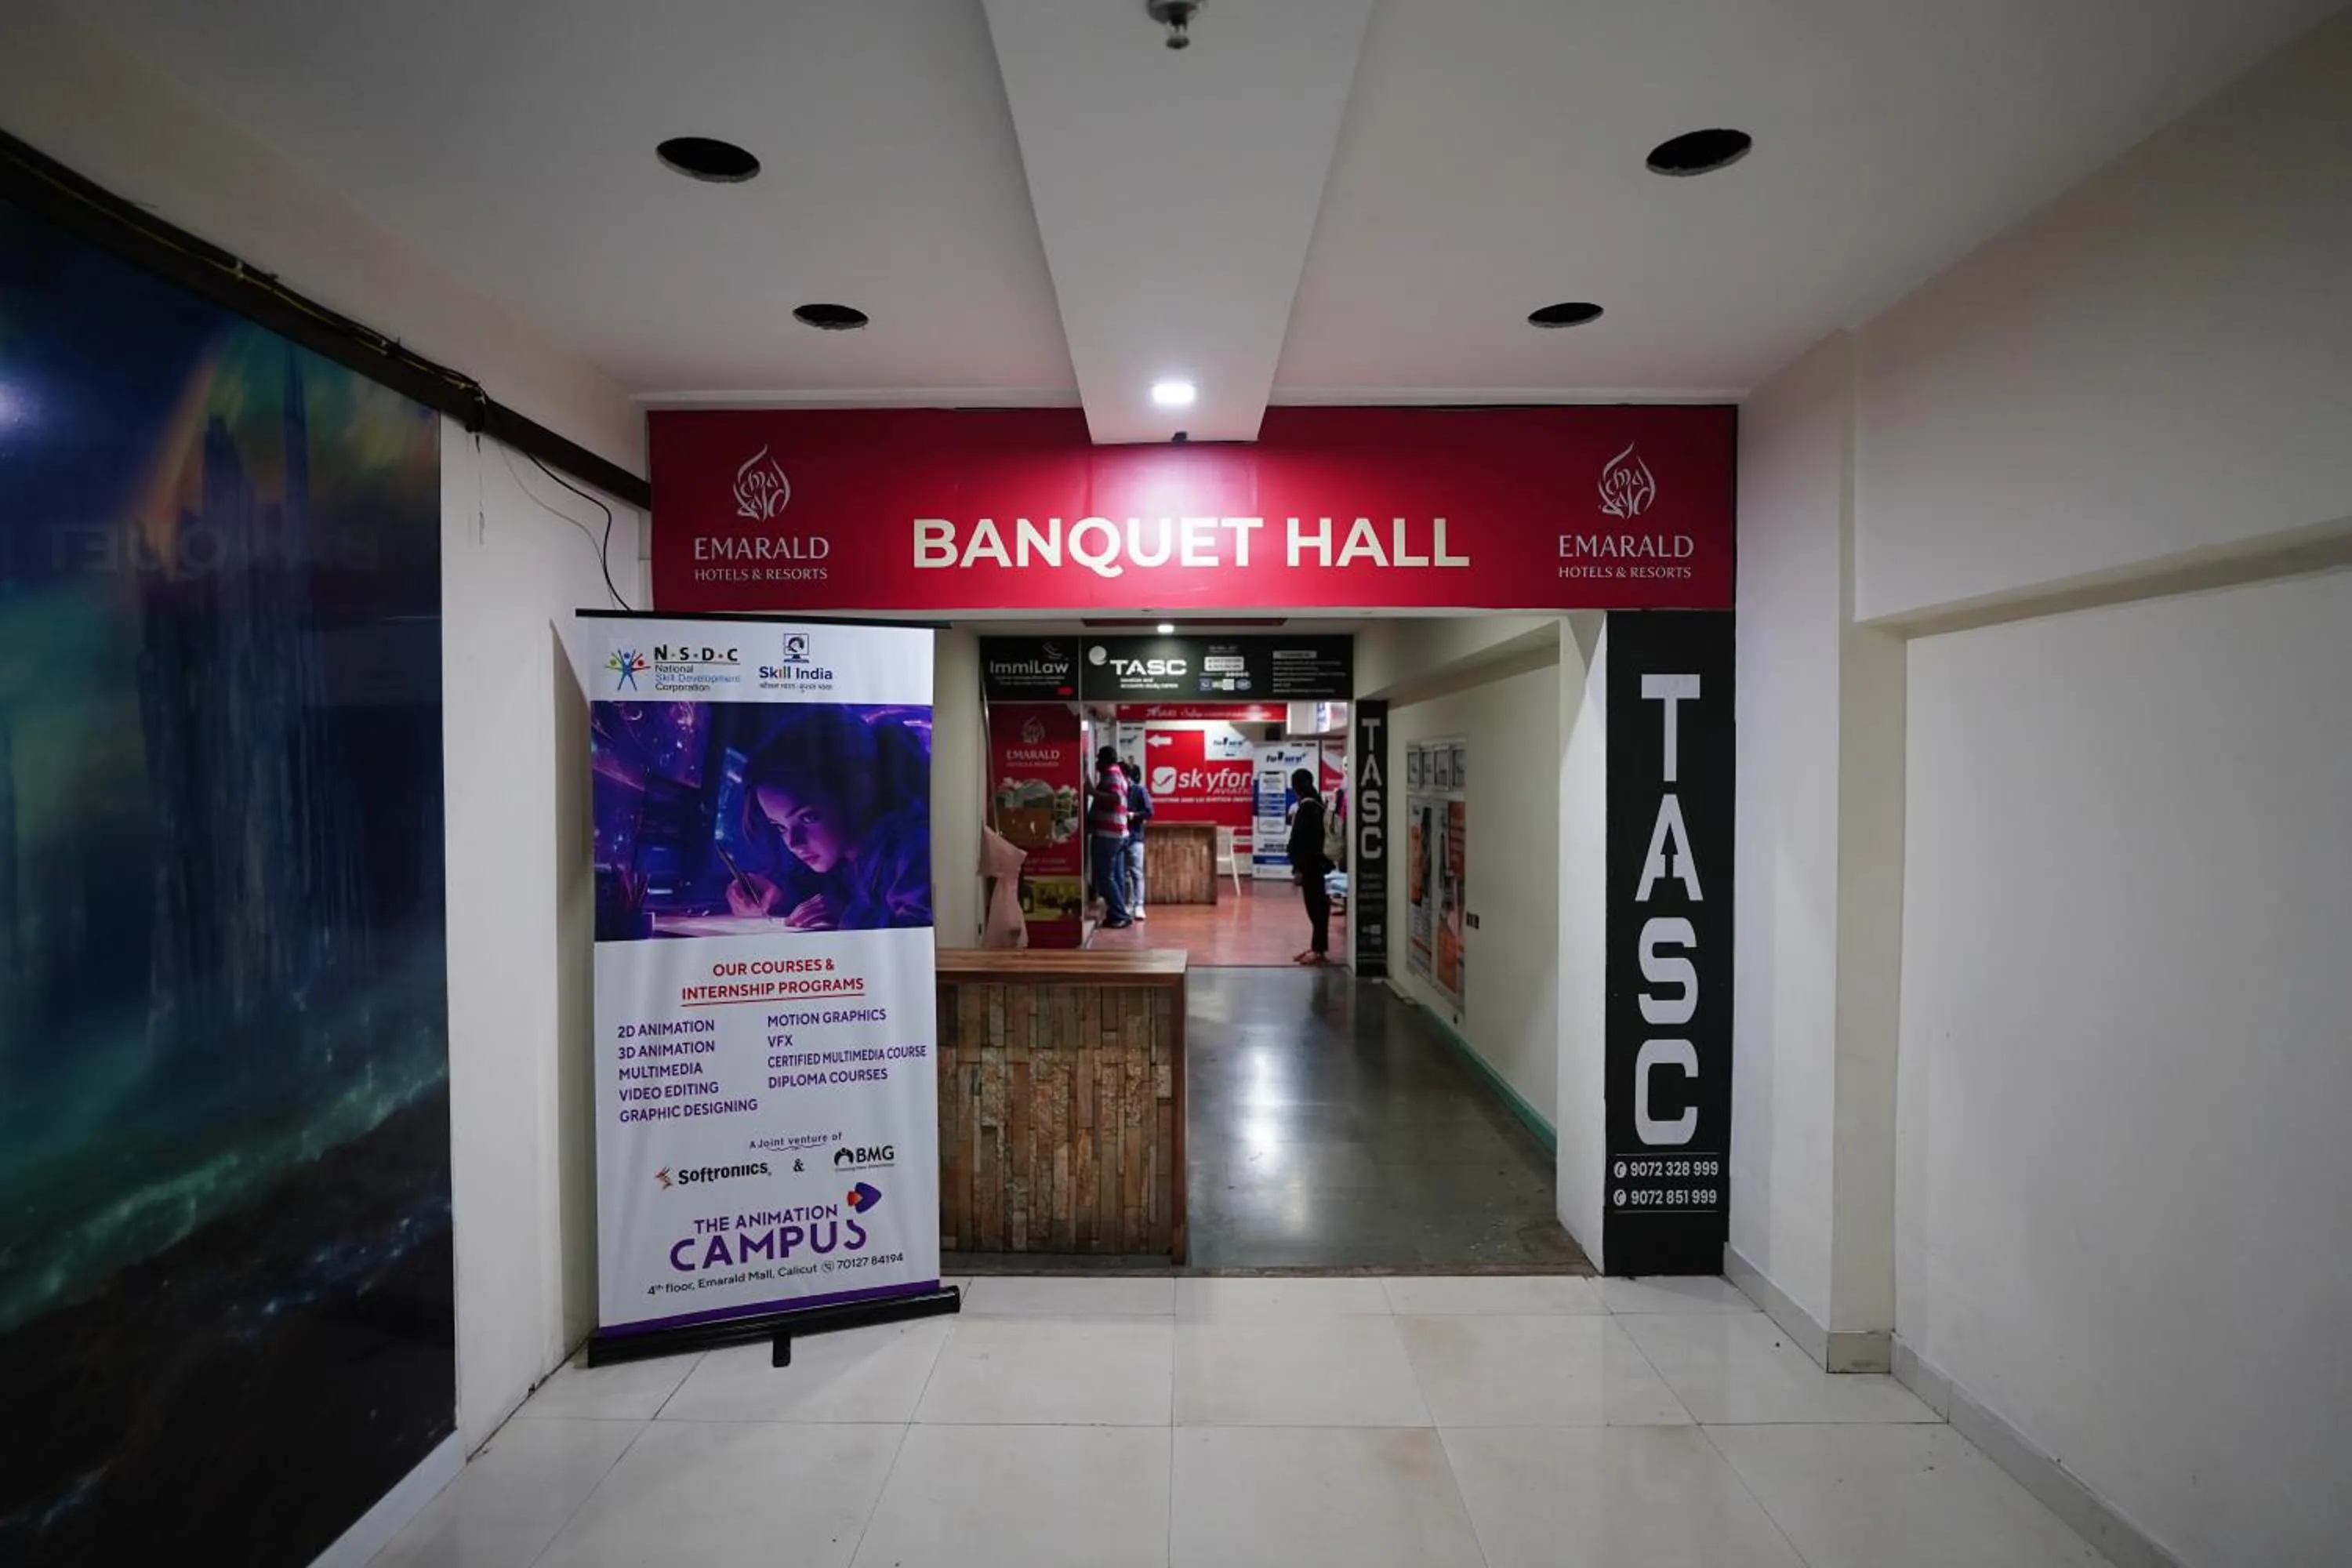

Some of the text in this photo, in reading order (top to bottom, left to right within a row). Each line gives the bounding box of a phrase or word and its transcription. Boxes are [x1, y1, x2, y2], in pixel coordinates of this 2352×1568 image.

[694, 537, 829, 560] EMARALD
[913, 517, 1470, 578] BANQUET HALL
[1558, 535, 1693, 557] EMARALD
[695, 567, 827, 581] HOTELS & RESORTS
[1559, 566, 1691, 579] HOTELS & RESORTS
[655, 664, 694, 673] National
[759, 666, 833, 680] Skill India
[990, 659, 1069, 674] ImmiLaw
[1109, 659, 1187, 675] TASC
[655, 684, 711, 692] Corporation
[1360, 719, 1383, 859] TASC
[1635, 673, 1704, 1146] TASC
[713, 959, 835, 978] OUR COURSES &
[681, 978, 864, 1000] INTERNSHIP PROGRAMS
[768, 1008, 887, 1028] MOTION GRAPHICS
[617, 1019, 715, 1038] 2D ANIMATION
[618, 1040, 715, 1060] 3D ANIMATION
[768, 1035, 793, 1048] VFX
[768, 1046, 927, 1068] CERTIFIED MULTIMEDIA COURSE
[619, 1062, 702, 1080] MULTIMEDIA
[768, 1069, 888, 1089] DIPLOMA COURSES
[619, 1082, 719, 1102] VIDEO EDITING
[619, 1099, 758, 1123] GRAPHIC DESIGNING
[758, 1137, 785, 1148] Joint
[788, 1133, 829, 1146] venture
[832, 1132, 843, 1142] of
[793, 1159, 805, 1174] &
[856, 1145, 895, 1163] BMG
[1631, 1160, 1719, 1177] 9072 328 999
[1631, 1189, 1717, 1205] 9072 851 999
[694, 1204, 838, 1234] THE ANIMATION
[670, 1219, 867, 1272] CAMPUS
[666, 1280, 695, 1294] floor,
[699, 1272, 746, 1289] Emarald
[748, 1269, 775, 1284] Mall,
[778, 1264, 818, 1278] Calicut
[837, 1256, 869, 1269] 70127
[871, 1253, 904, 1266] 84194
